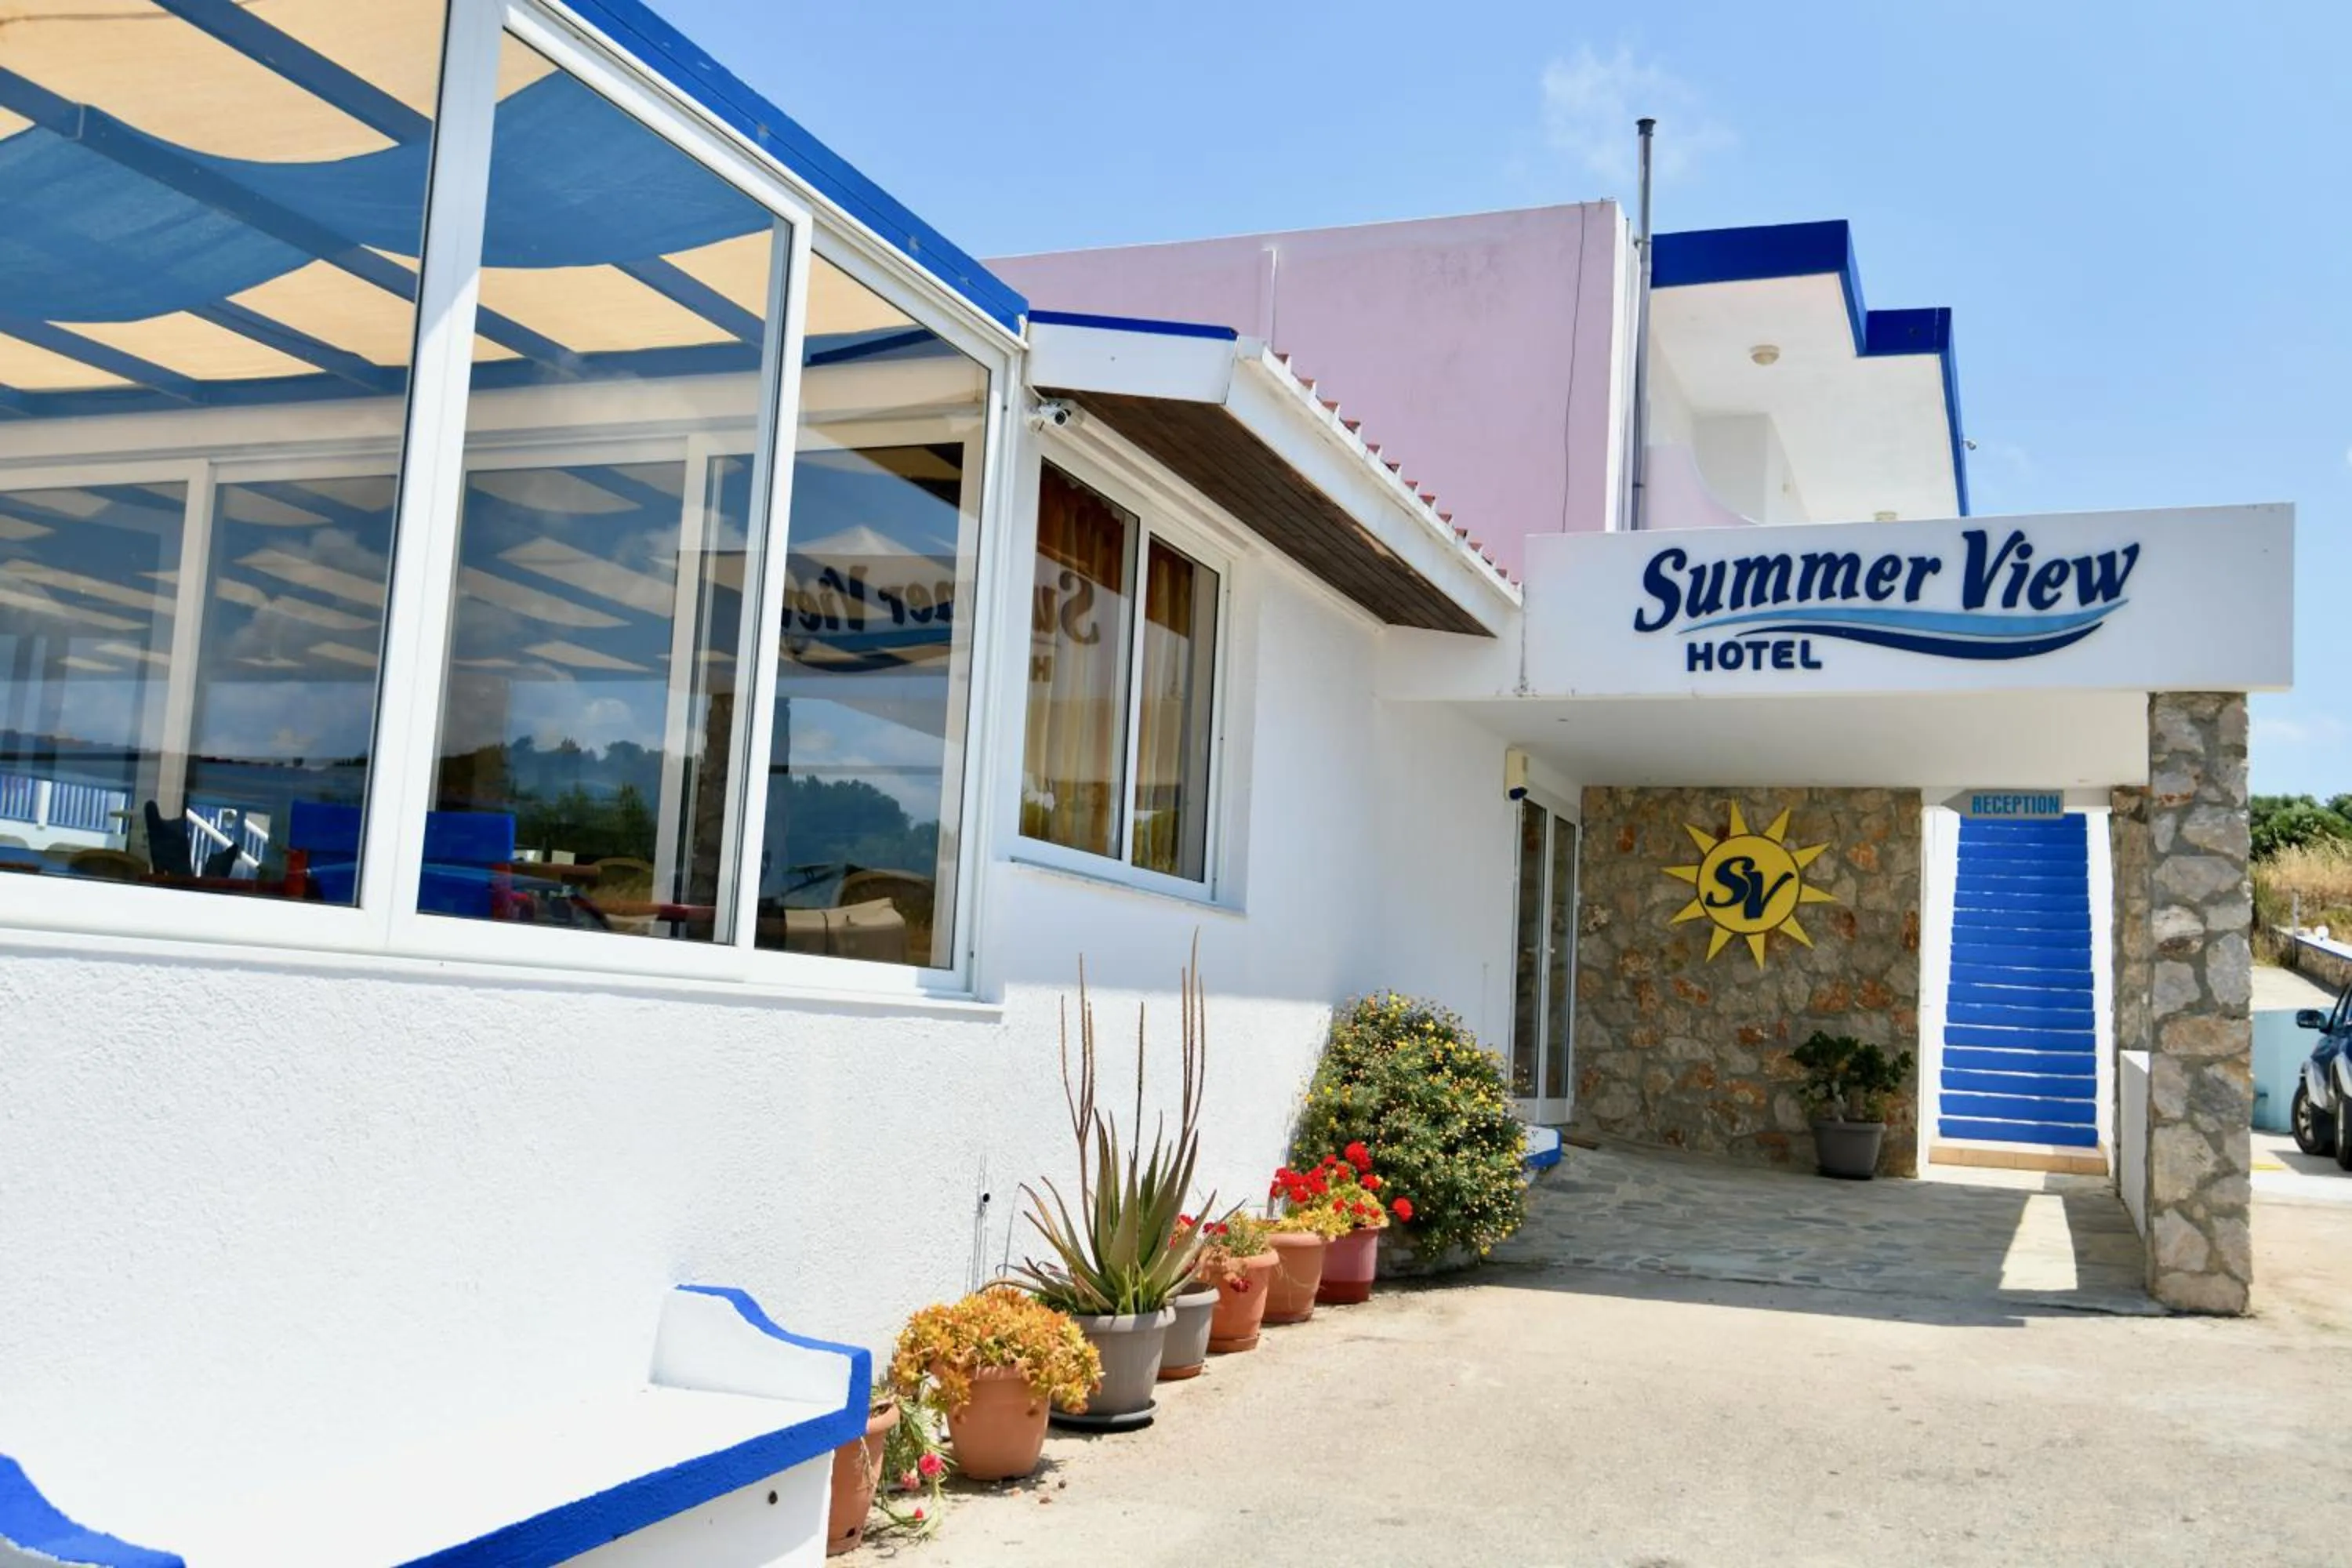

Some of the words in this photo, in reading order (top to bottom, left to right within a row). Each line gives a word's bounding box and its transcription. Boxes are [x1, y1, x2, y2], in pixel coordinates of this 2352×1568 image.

[1634, 547, 1942, 633] Summer
[1962, 529, 2140, 612] View
[1687, 640, 1823, 672] HOTEL
[1971, 794, 2060, 815] RECEPTION
[1704, 856, 1795, 920] SV
